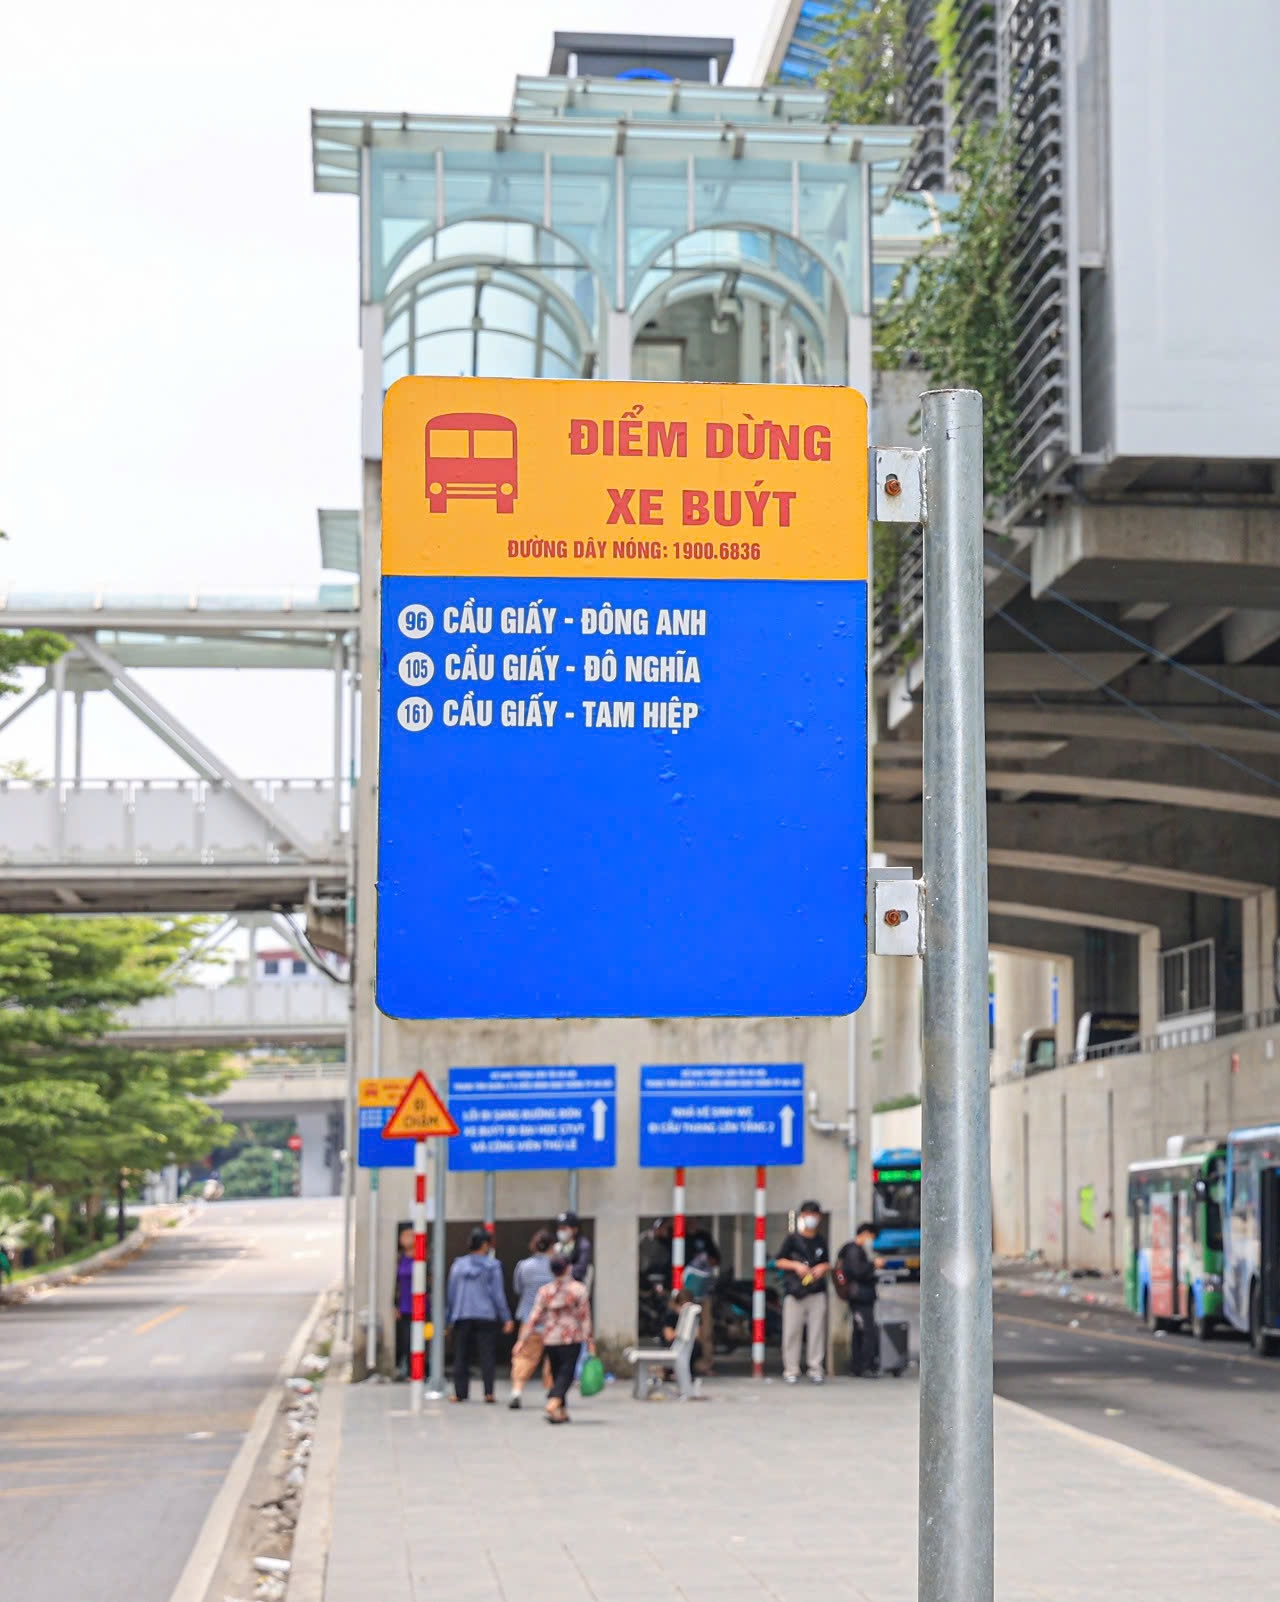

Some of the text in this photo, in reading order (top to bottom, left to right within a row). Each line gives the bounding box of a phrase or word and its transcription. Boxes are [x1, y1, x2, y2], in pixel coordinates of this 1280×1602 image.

[569, 404, 831, 461] ĐIỂM DỪNG
[606, 480, 796, 527] XE BUÝT
[508, 536, 761, 560] ĐƯỜNG DÂY NÓNG: 1900.6836
[405, 611, 427, 631] 96
[443, 597, 492, 634] CẦU
[501, 598, 556, 634] GIẤY
[581, 602, 648, 635] ĐÔNG
[656, 609, 706, 636] ANH
[405, 658, 428, 680] 105
[445, 644, 494, 681] CẦU
[503, 645, 559, 681] GIẤY
[584, 649, 617, 682] ĐÔ
[625, 650, 700, 683] NGHĨA
[404, 704, 428, 724] 161
[443, 691, 492, 727] CẦU
[502, 692, 558, 727] GIẤY
[582, 701, 634, 728] TAM
[643, 696, 698, 734] HIỆP
